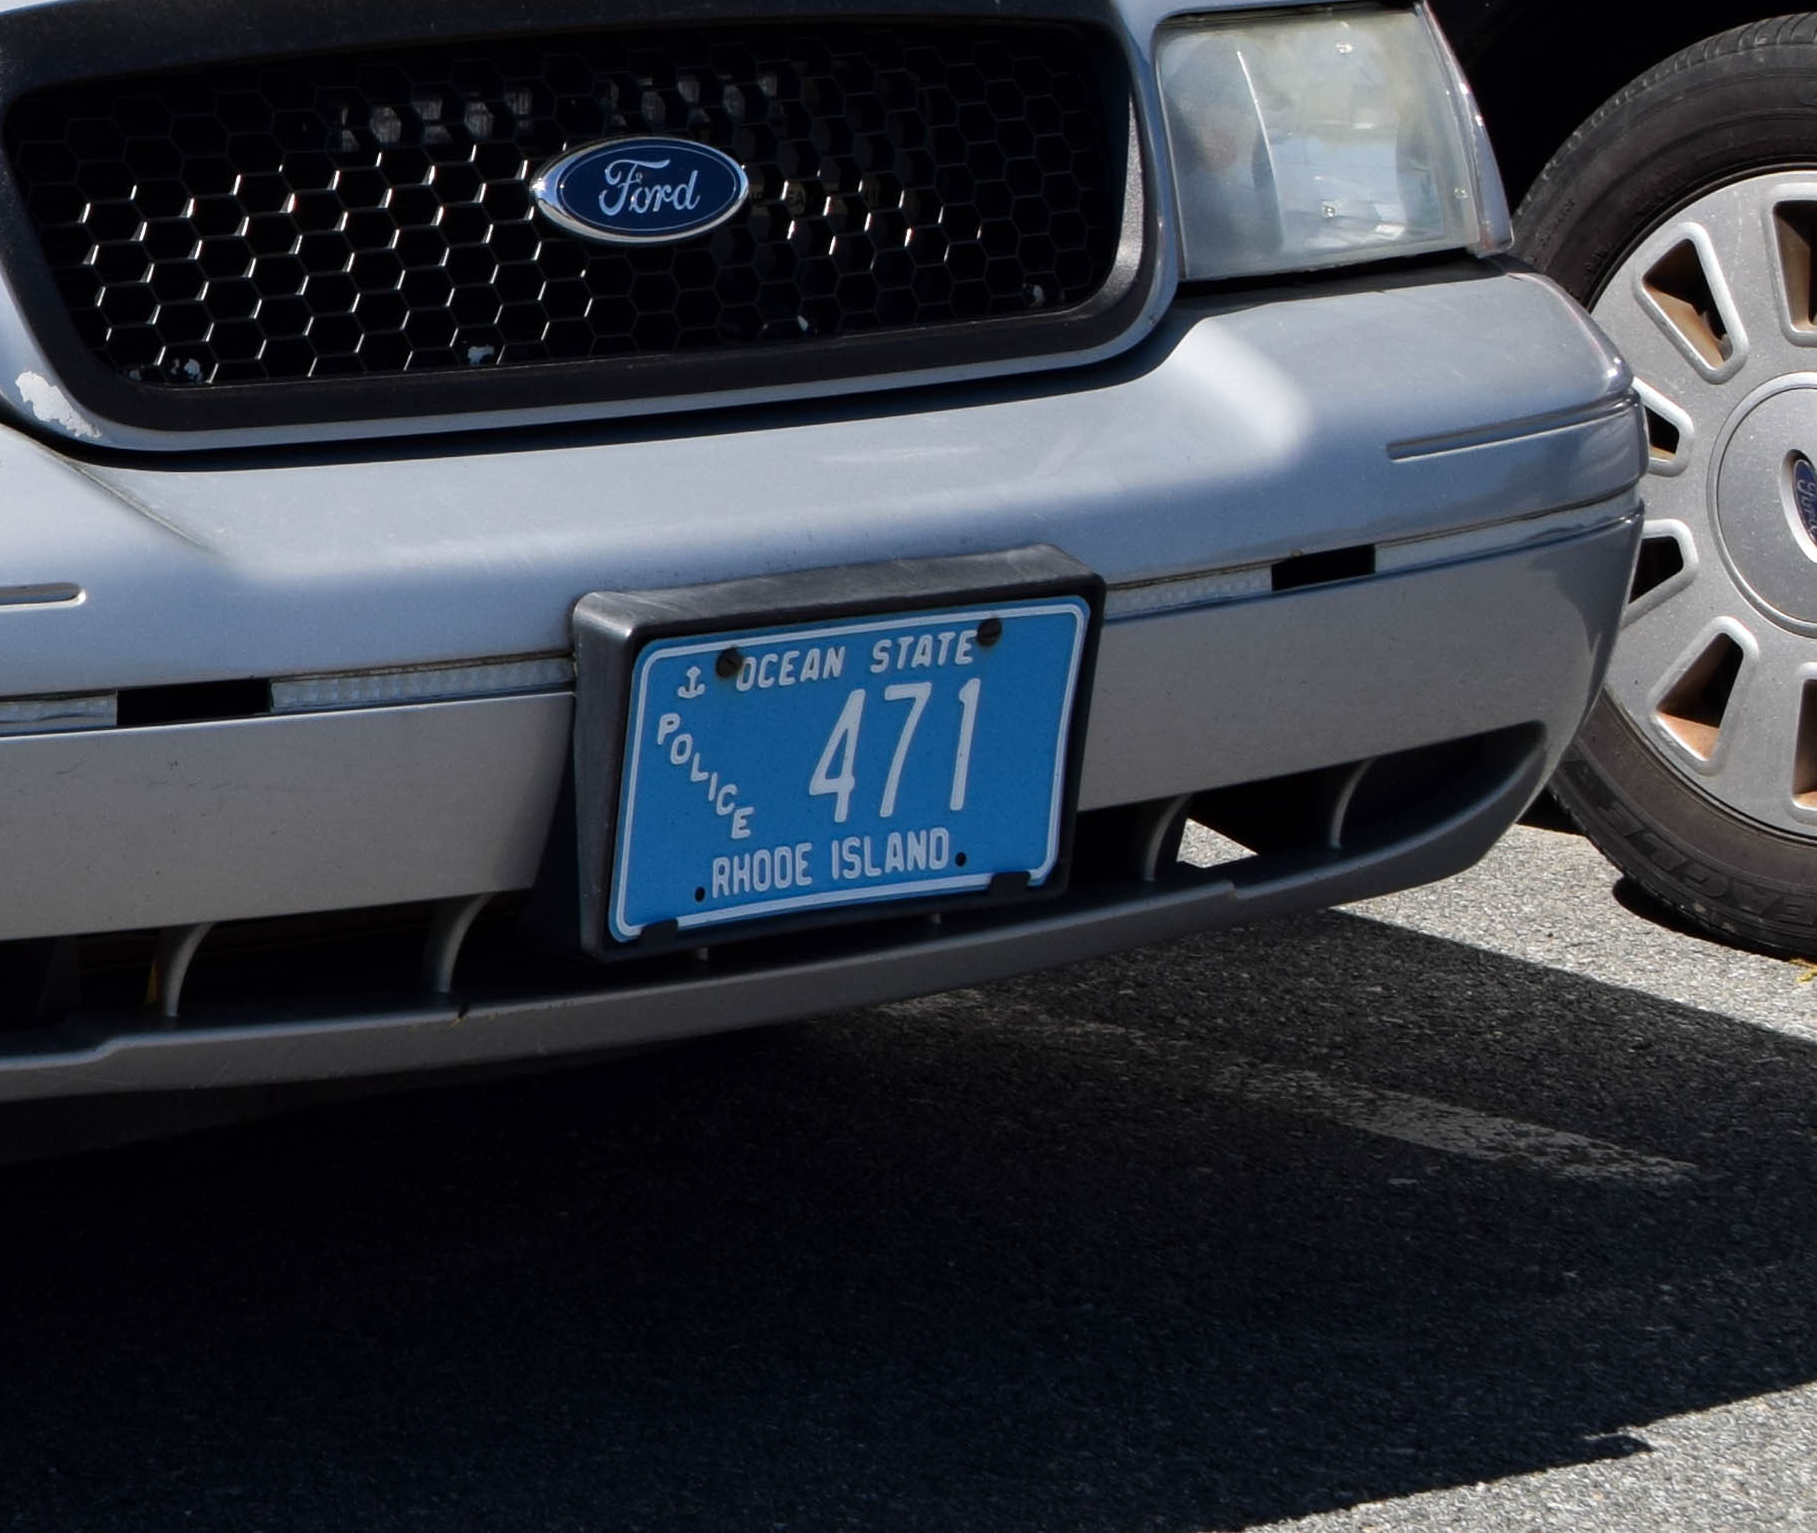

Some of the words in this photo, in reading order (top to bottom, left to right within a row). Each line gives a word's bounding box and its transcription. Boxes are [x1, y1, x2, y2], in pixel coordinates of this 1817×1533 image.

[598, 159, 701, 217] Ford
[736, 646, 845, 692] OCEAN
[870, 630, 977, 674] STATE
[657, 713, 754, 839] POLICE
[808, 677, 981, 824] 471
[712, 843, 813, 899] RHODE
[832, 827, 949, 881] ISLAND
